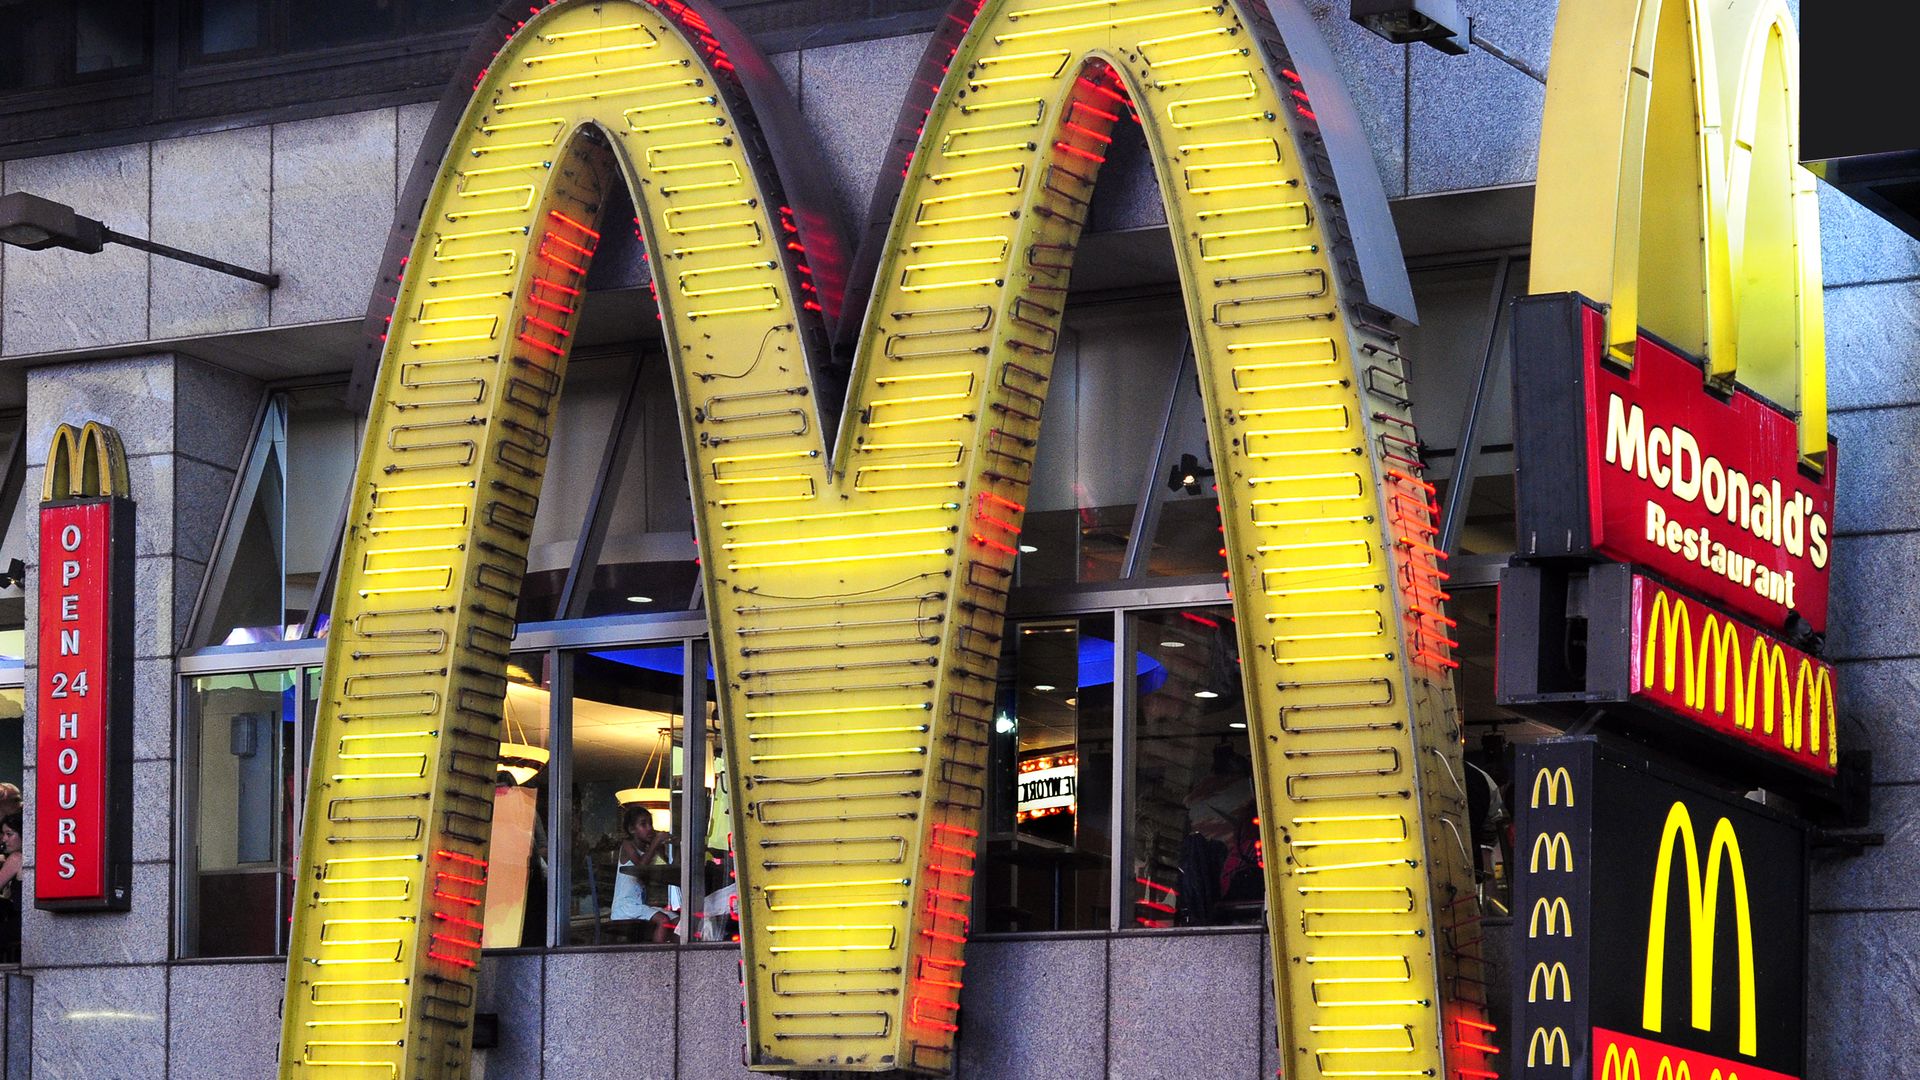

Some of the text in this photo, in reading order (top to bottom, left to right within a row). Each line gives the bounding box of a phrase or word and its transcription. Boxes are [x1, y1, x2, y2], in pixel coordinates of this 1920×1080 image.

[1605, 393, 1829, 568] McDonald's
[1646, 500, 1796, 609] Restaurant
[51, 524, 89, 878] OPEN 24 HOURS
